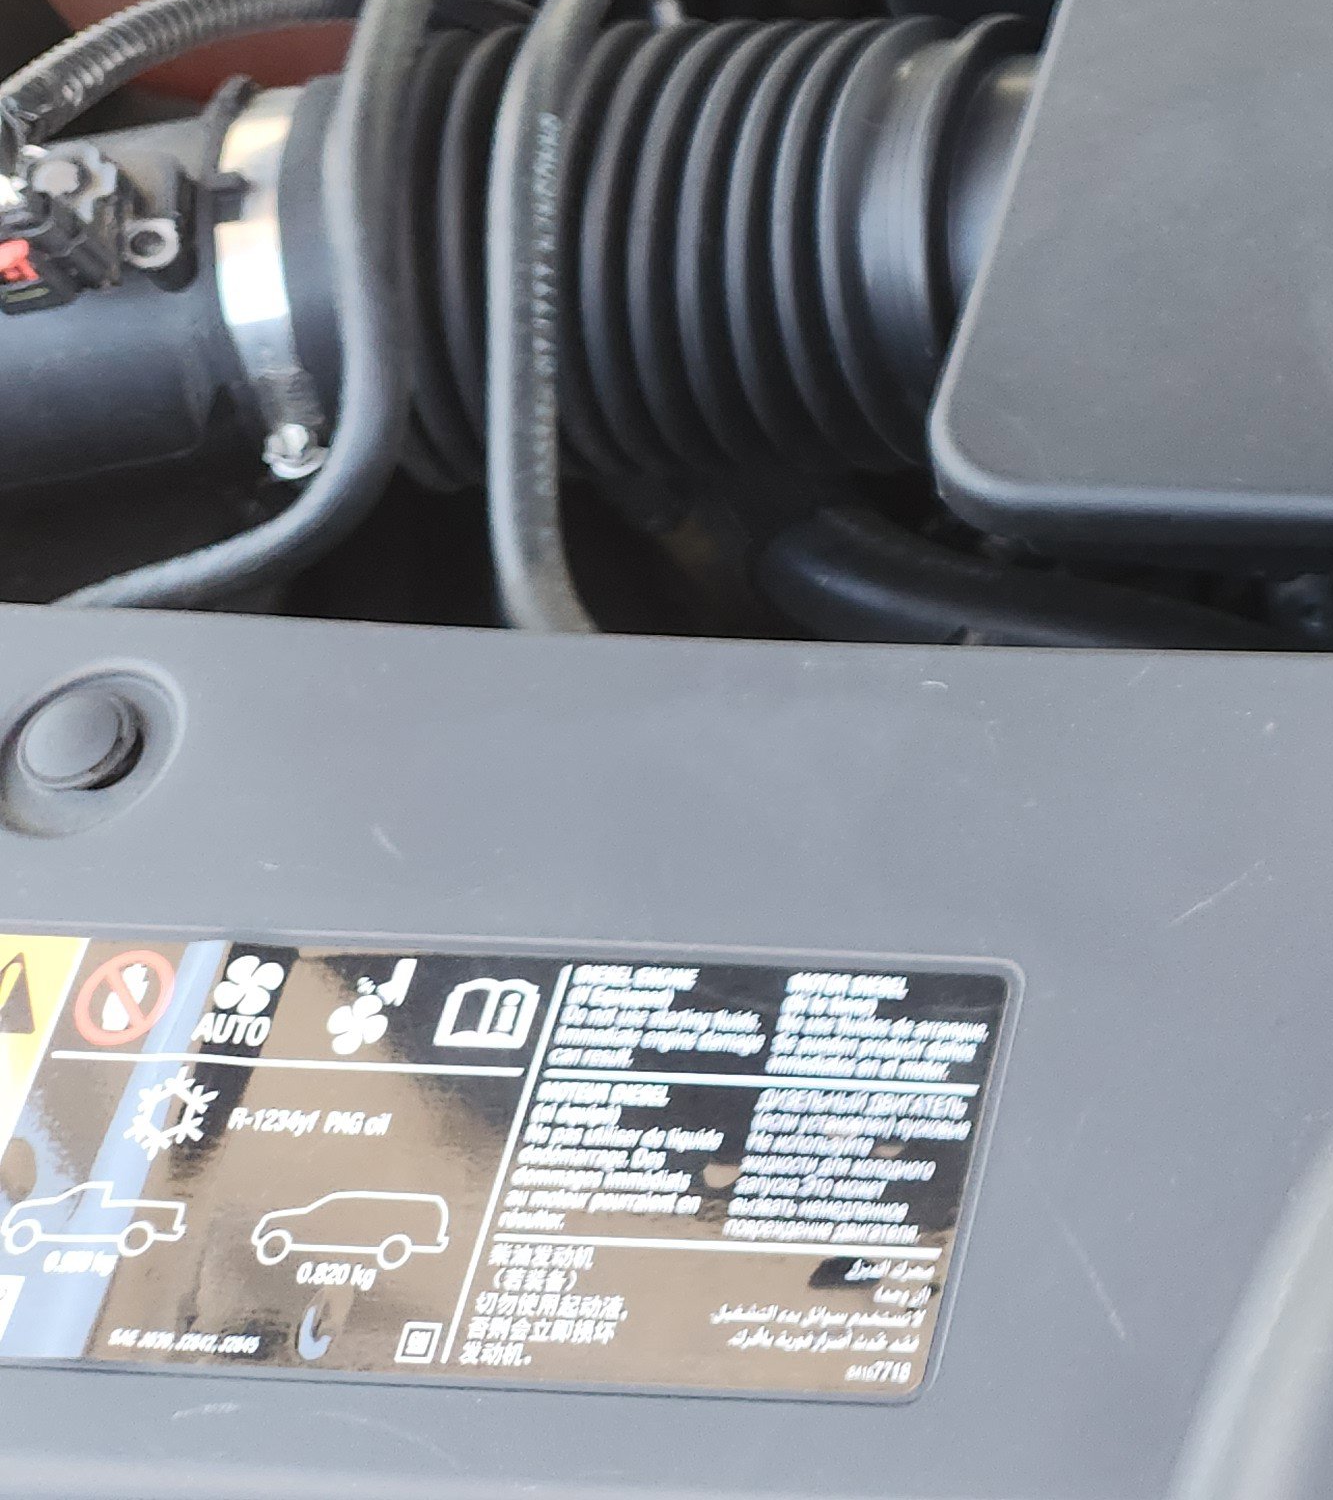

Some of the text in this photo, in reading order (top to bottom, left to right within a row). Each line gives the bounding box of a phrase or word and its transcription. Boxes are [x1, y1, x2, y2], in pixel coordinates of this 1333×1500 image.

[190, 1012, 271, 1047] AUTO
[323, 1111, 365, 1135] PAG
[363, 1113, 392, 1136] oil
[296, 1261, 377, 1291] 0.820 kg
